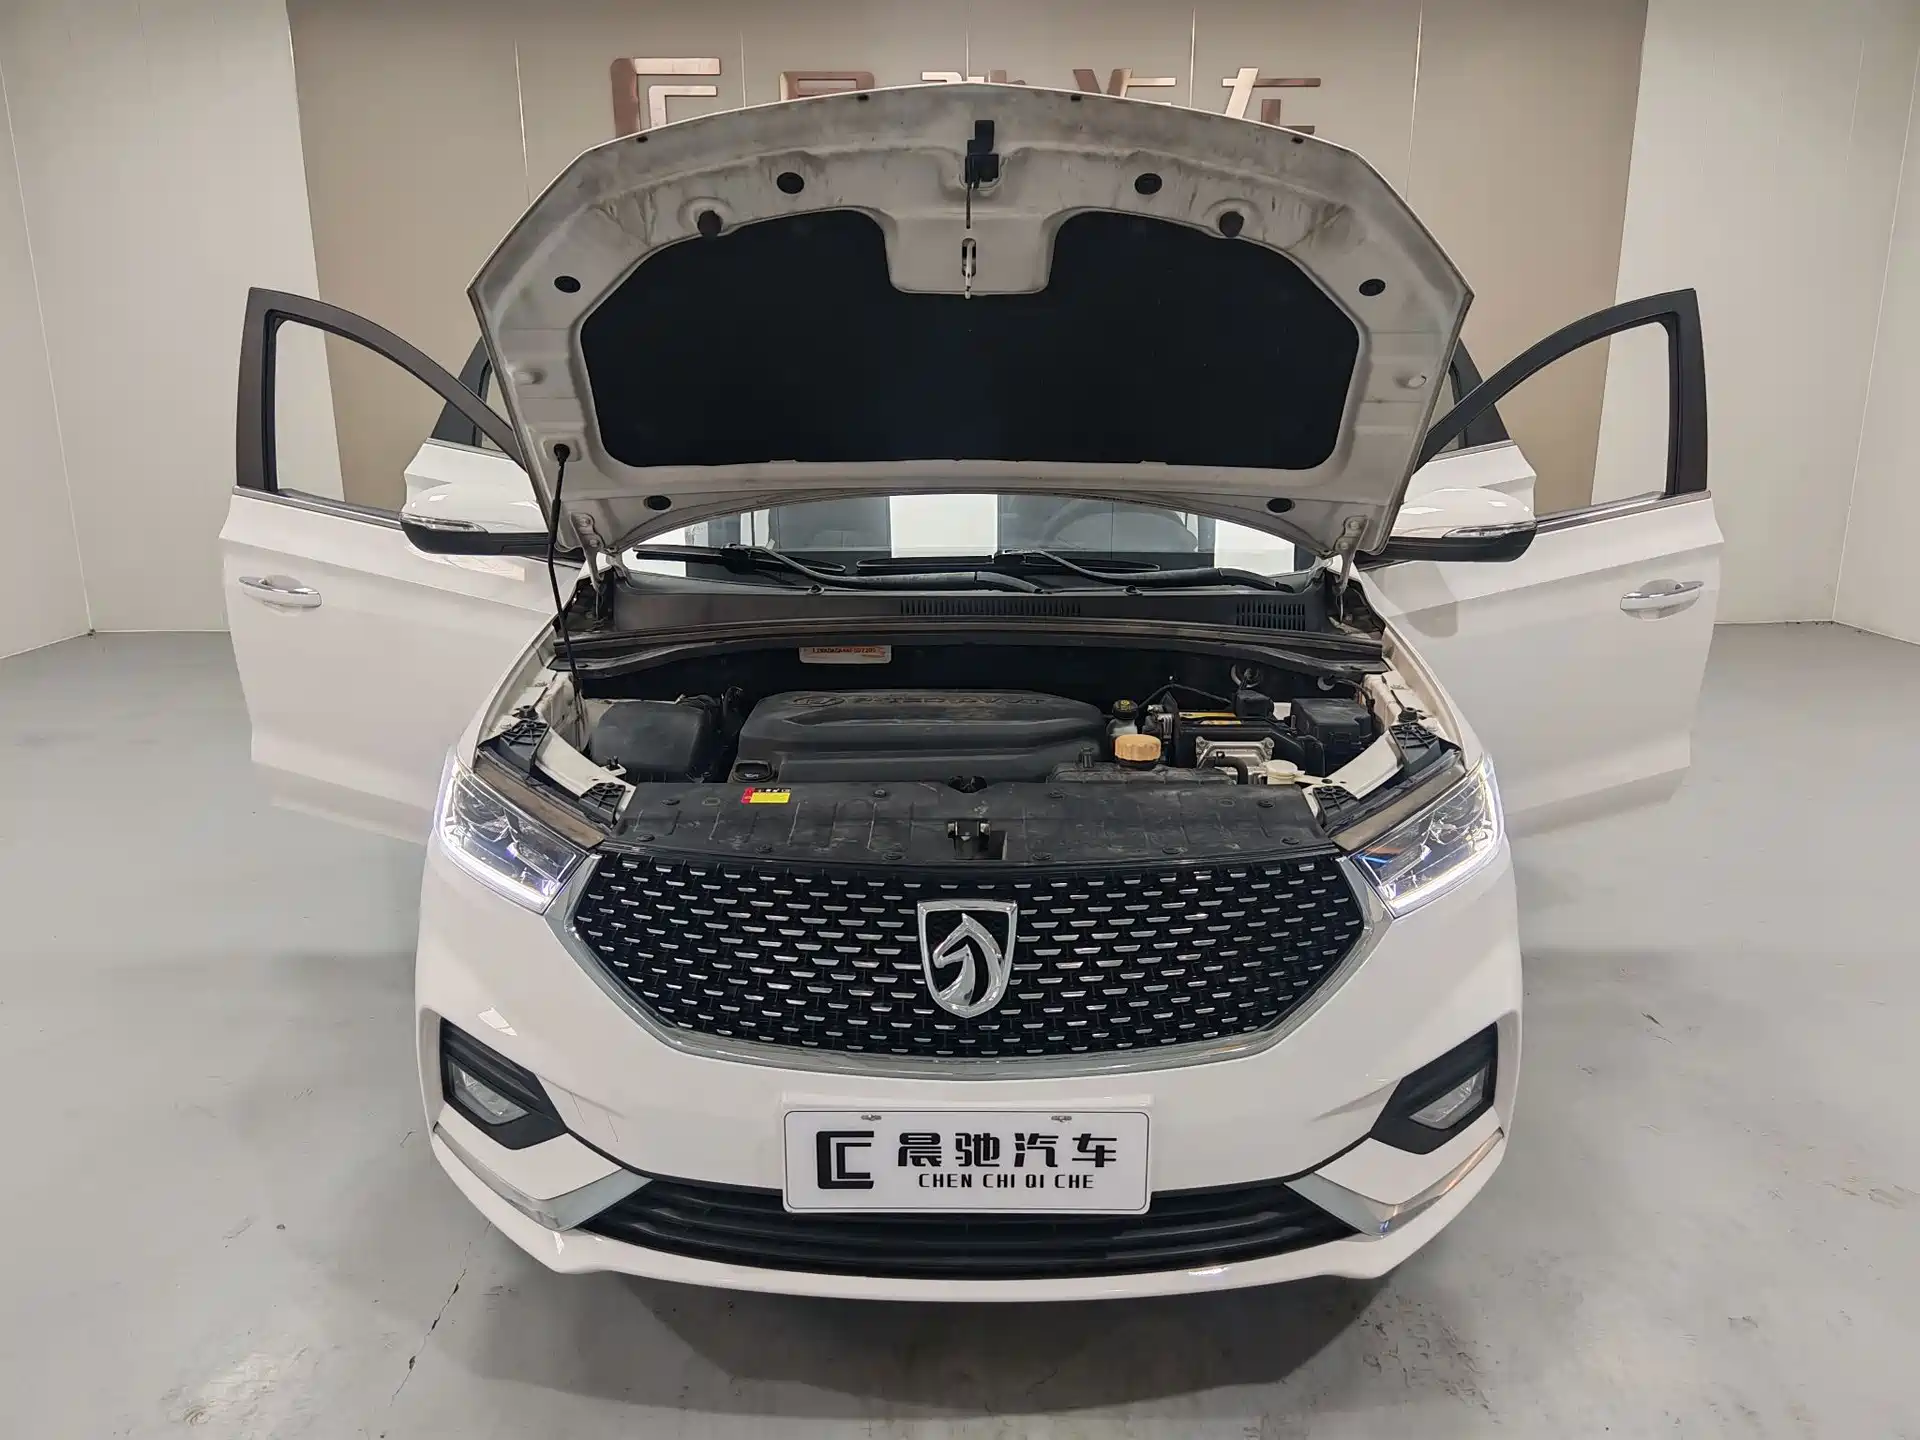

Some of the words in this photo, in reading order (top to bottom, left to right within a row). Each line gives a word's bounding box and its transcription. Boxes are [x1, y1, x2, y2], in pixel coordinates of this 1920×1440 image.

[898, 1132, 1118, 1168] 晨驰汽车
[918, 1173, 973, 1189] CHEN
[982, 1173, 1016, 1189] CHI
[1025, 1174, 1045, 1189] QI
[1054, 1174, 1094, 1189] CHE
